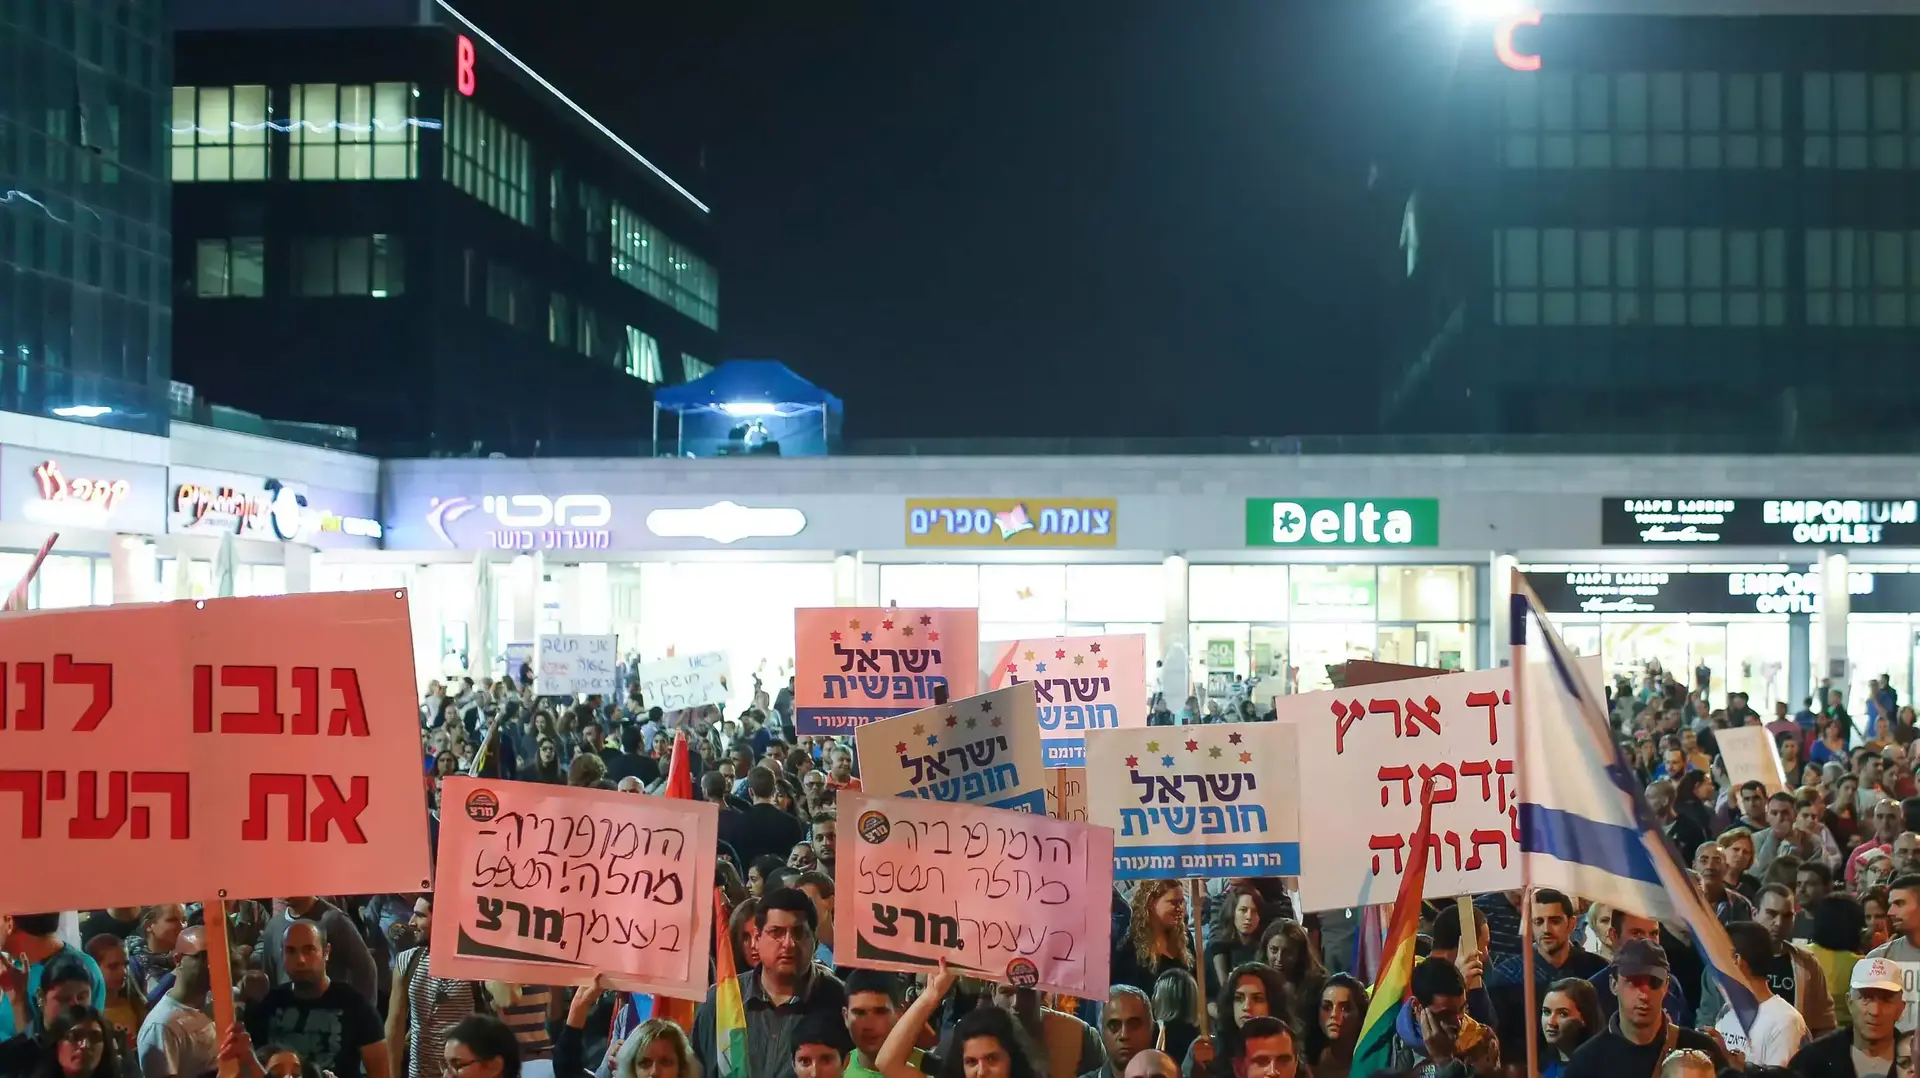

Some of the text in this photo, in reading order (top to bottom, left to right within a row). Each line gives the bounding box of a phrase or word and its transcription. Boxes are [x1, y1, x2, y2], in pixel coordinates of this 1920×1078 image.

[1494, 10, 1542, 71] C
[457, 34, 475, 97] B
[910, 508, 1111, 535] צומת ספרים
[1272, 501, 1413, 543] Delta
[1763, 500, 1917, 524] EMPORIUM
[487, 530, 609, 549] מועדוני כושר
[1792, 524, 1884, 543] OUTLET
[834, 643, 942, 673] ישראל
[193, 664, 370, 737] גנבו
[824, 675, 949, 699] חופשית
[1330, 695, 1441, 755] ארץ
[900, 736, 1008, 785] ישראל
[1048, 746, 1087, 759] דומם
[1130, 770, 1256, 804] ישראל
[0, 769, 369, 844] את העיר
[1119, 804, 1268, 836] חופשית
[1181, 853, 1236, 868] הדומם
[1242, 852, 1281, 868] הרוב
[966, 859, 1071, 905] מחלה
